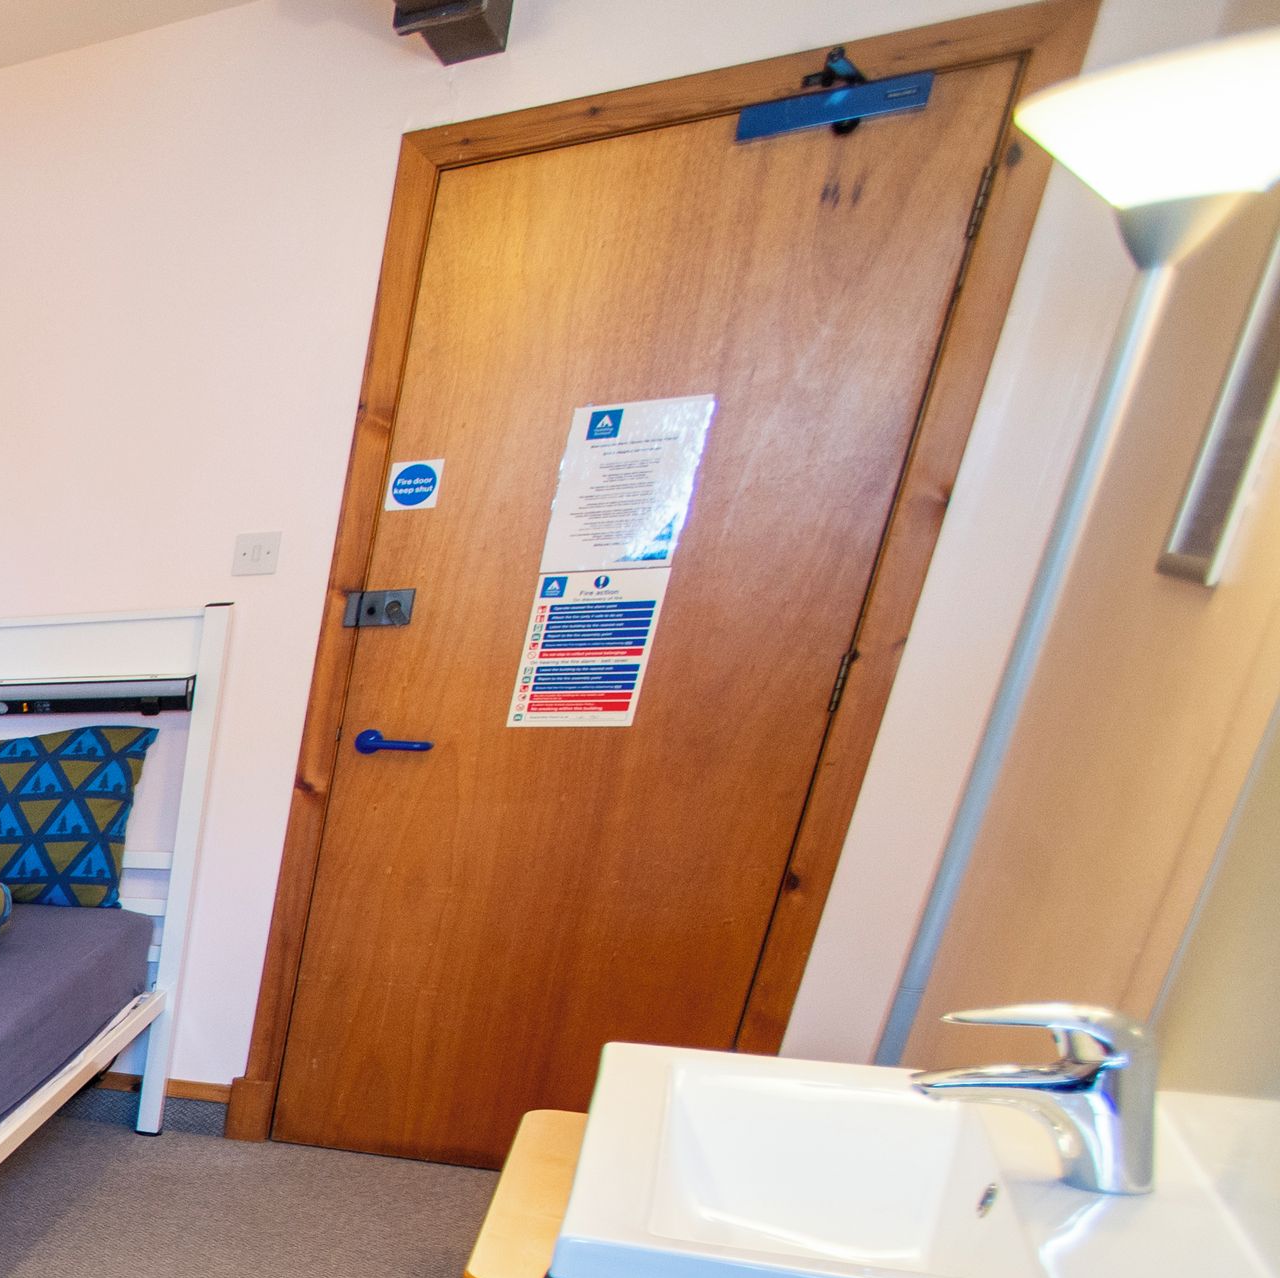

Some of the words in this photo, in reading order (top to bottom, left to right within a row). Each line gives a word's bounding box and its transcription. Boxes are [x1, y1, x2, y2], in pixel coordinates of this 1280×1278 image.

[397, 478, 412, 486] Fire
[413, 477, 433, 485] door
[394, 487, 414, 495] keep
[415, 485, 433, 493] shut
